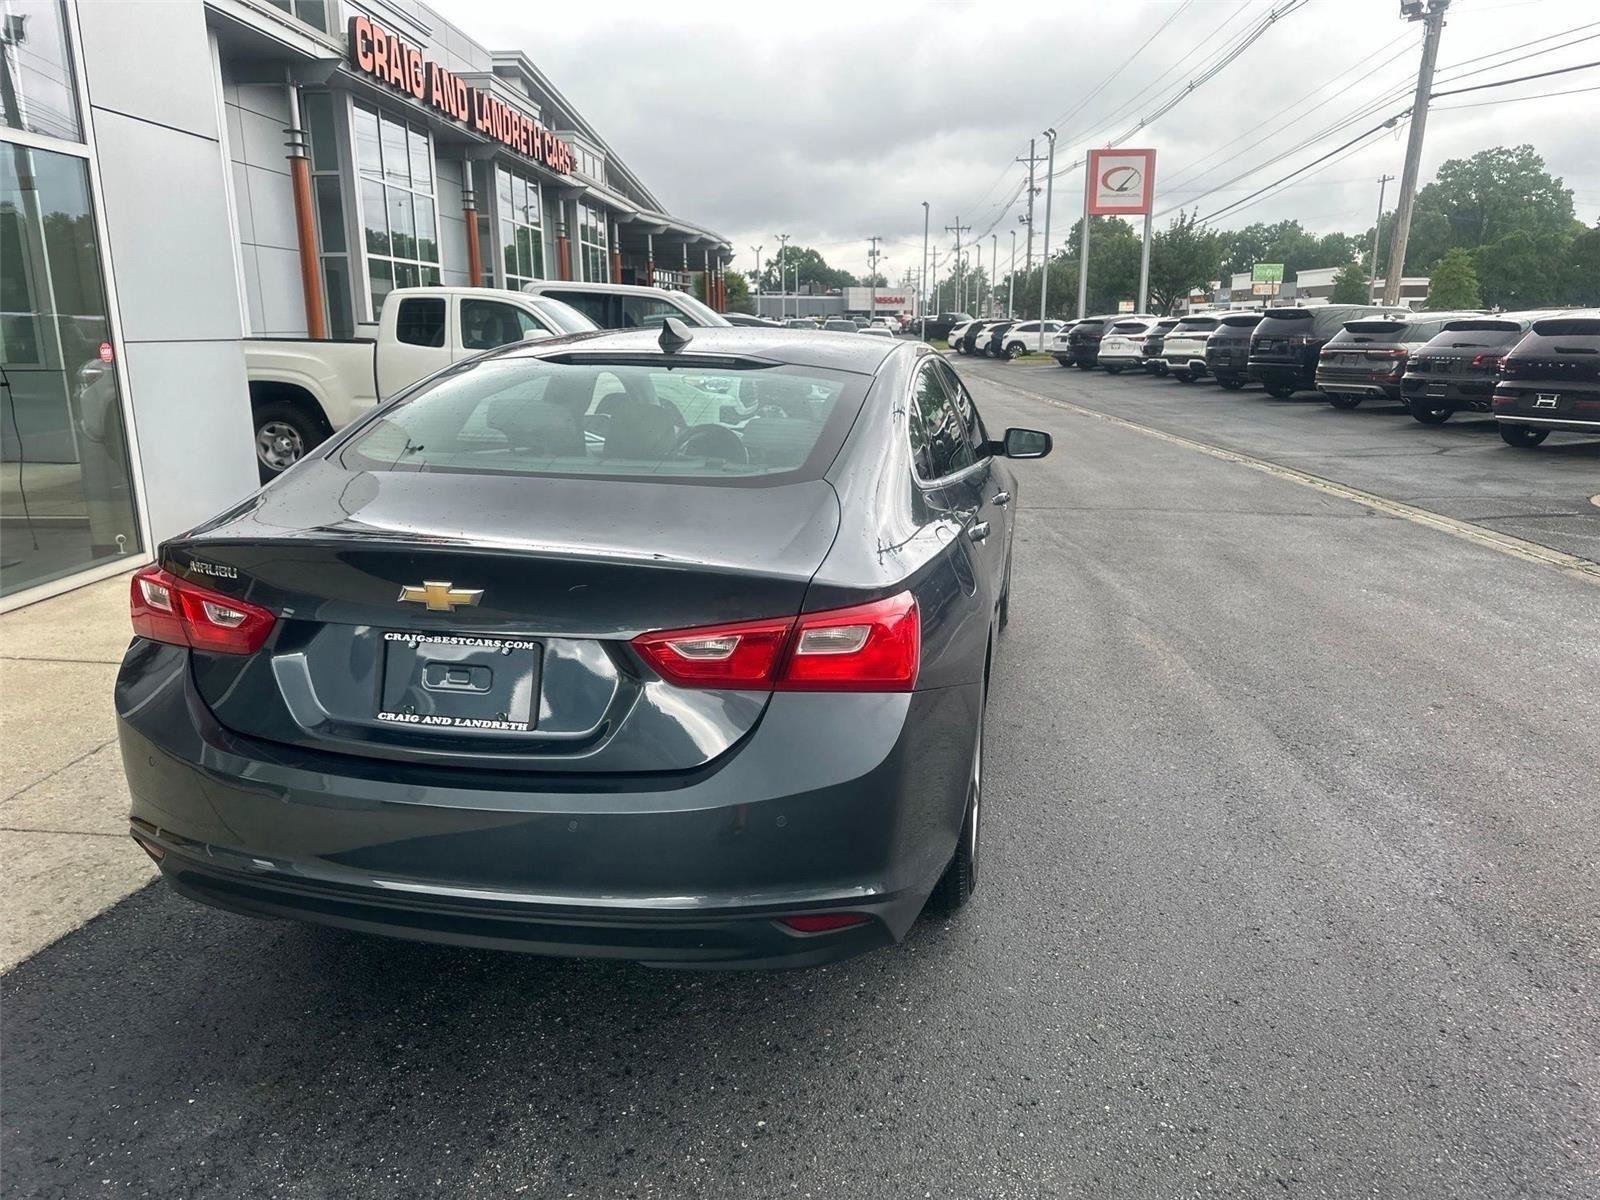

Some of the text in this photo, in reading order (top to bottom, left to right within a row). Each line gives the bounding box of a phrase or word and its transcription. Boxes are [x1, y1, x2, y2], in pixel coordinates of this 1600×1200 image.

[351, 16, 572, 176] CRAIG AND LANDRETH CARS
[873, 296, 905, 304] NISSAN
[189, 560, 238, 579] MALIBU
[377, 712, 528, 731] CRAIG AND LANDRETH
